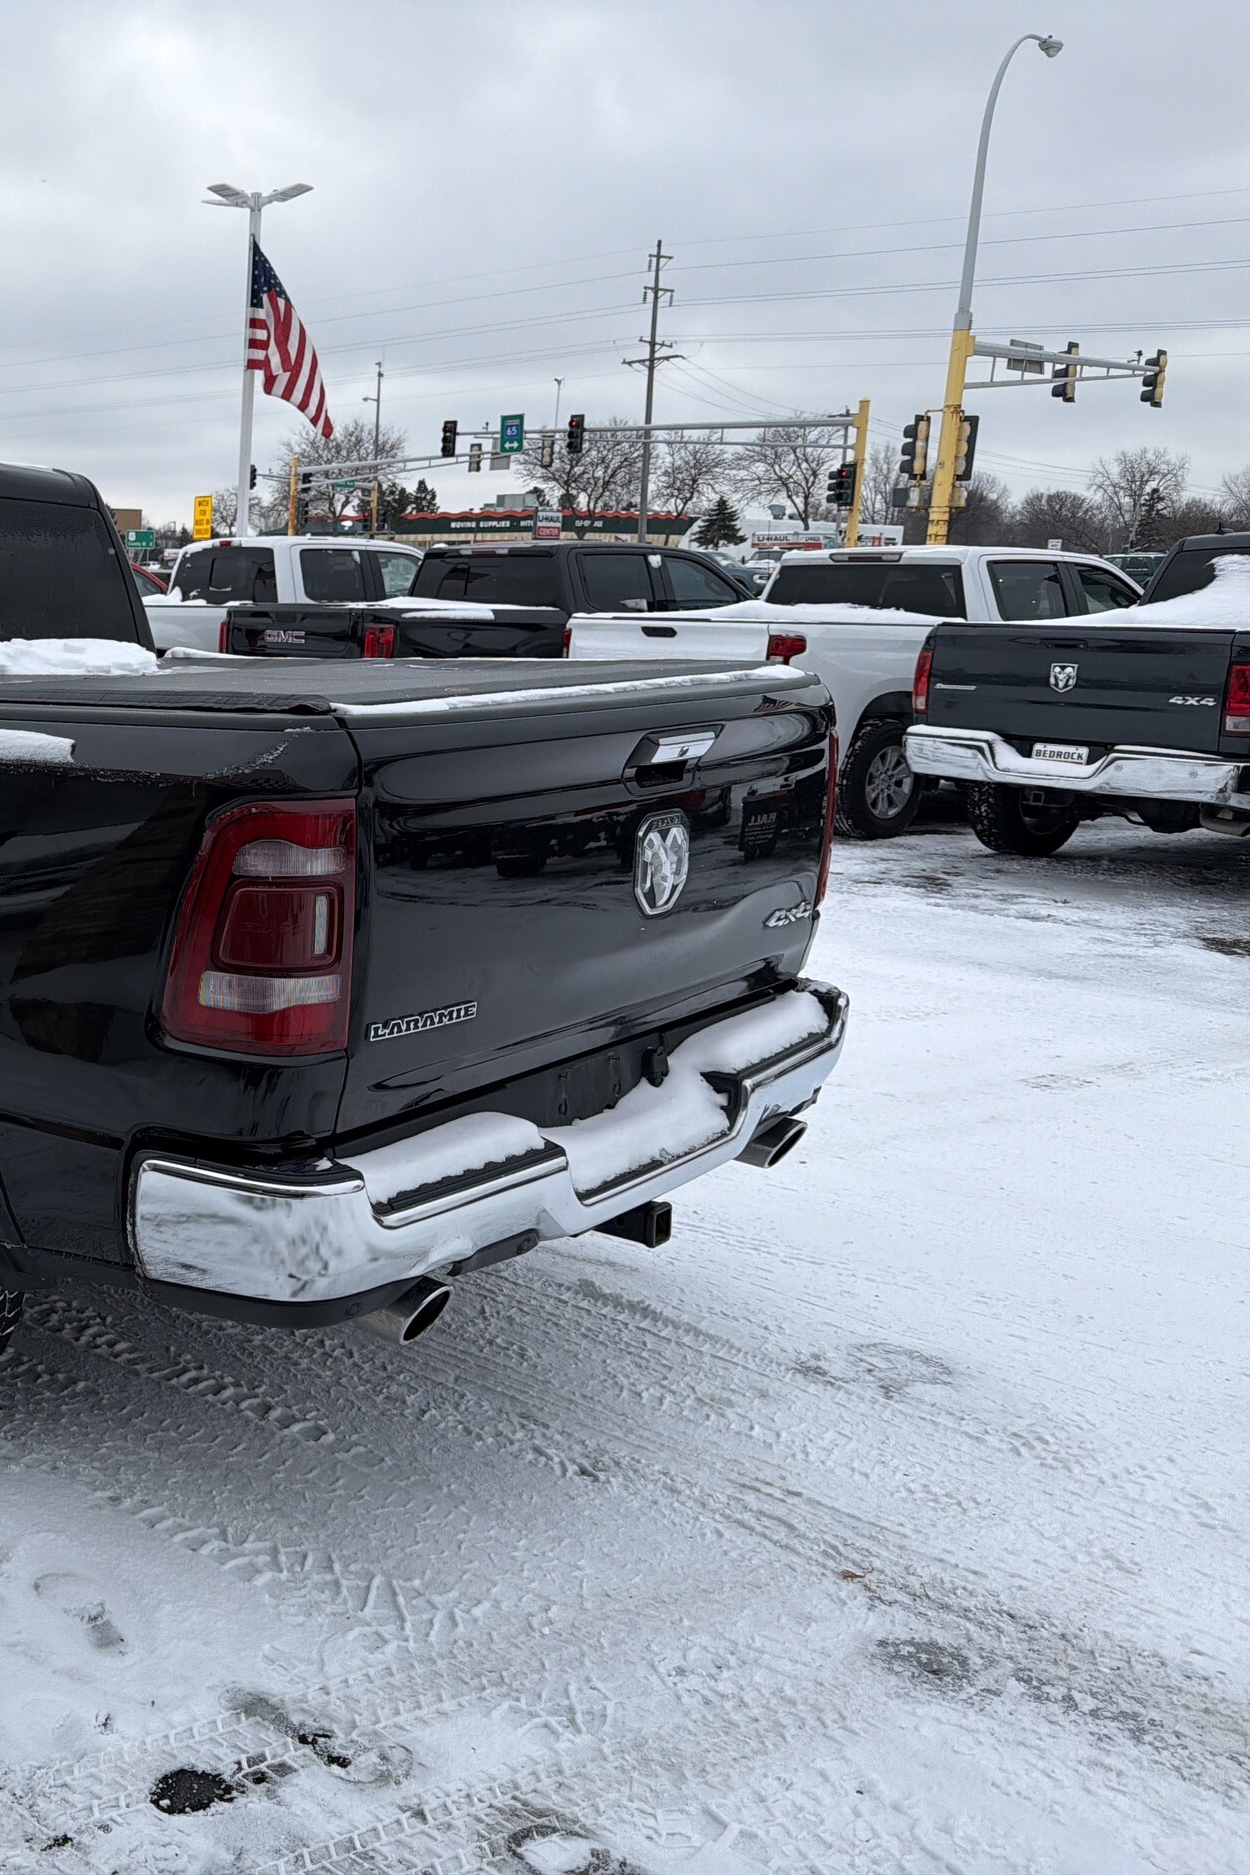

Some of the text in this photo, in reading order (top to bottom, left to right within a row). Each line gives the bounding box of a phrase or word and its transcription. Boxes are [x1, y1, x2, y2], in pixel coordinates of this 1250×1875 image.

[506, 425, 518, 436] 65
[479, 520, 510, 528] SUPPLIES
[538, 514, 561, 523] U-HAUL
[264, 629, 306, 644] GMC
[1034, 748, 1085, 762] BEDROCK
[365, 1000, 478, 1042] LARAMIE
